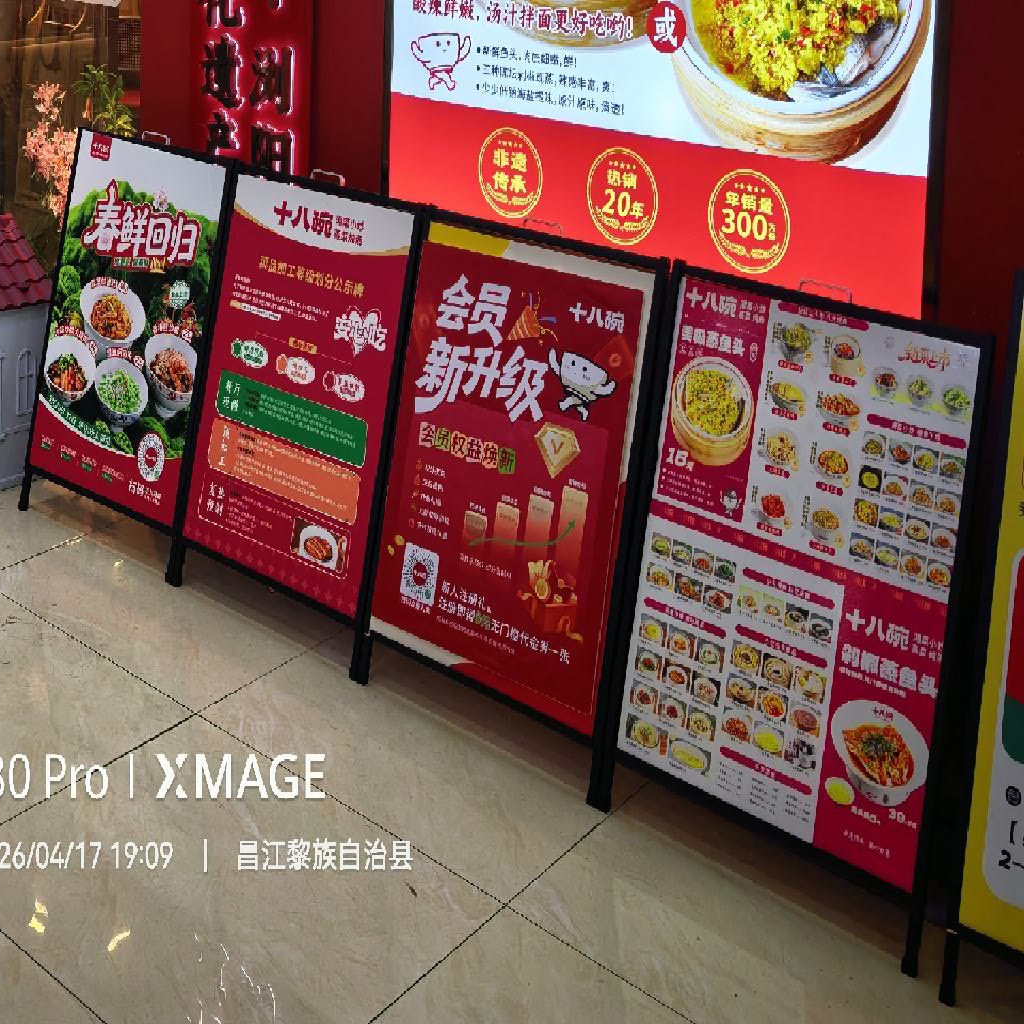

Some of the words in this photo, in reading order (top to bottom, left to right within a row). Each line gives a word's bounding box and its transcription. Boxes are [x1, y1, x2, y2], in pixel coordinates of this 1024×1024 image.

[653, 7, 677, 47] 或
[493, 148, 528, 173] 非遗
[492, 171, 528, 194] 传承
[606, 169, 638, 191] 热销
[274, 201, 333, 238] 十八碗
[602, 188, 644, 220] 20年
[725, 191, 774, 216] 年销量
[84, 185, 197, 264] 春鲜回归
[435, 273, 512, 347] 会员
[569, 302, 625, 334] 十八碗
[686, 287, 738, 318] 十八碗
[415, 337, 549, 423] 新升级
[845, 608, 910, 651] 十八碗
